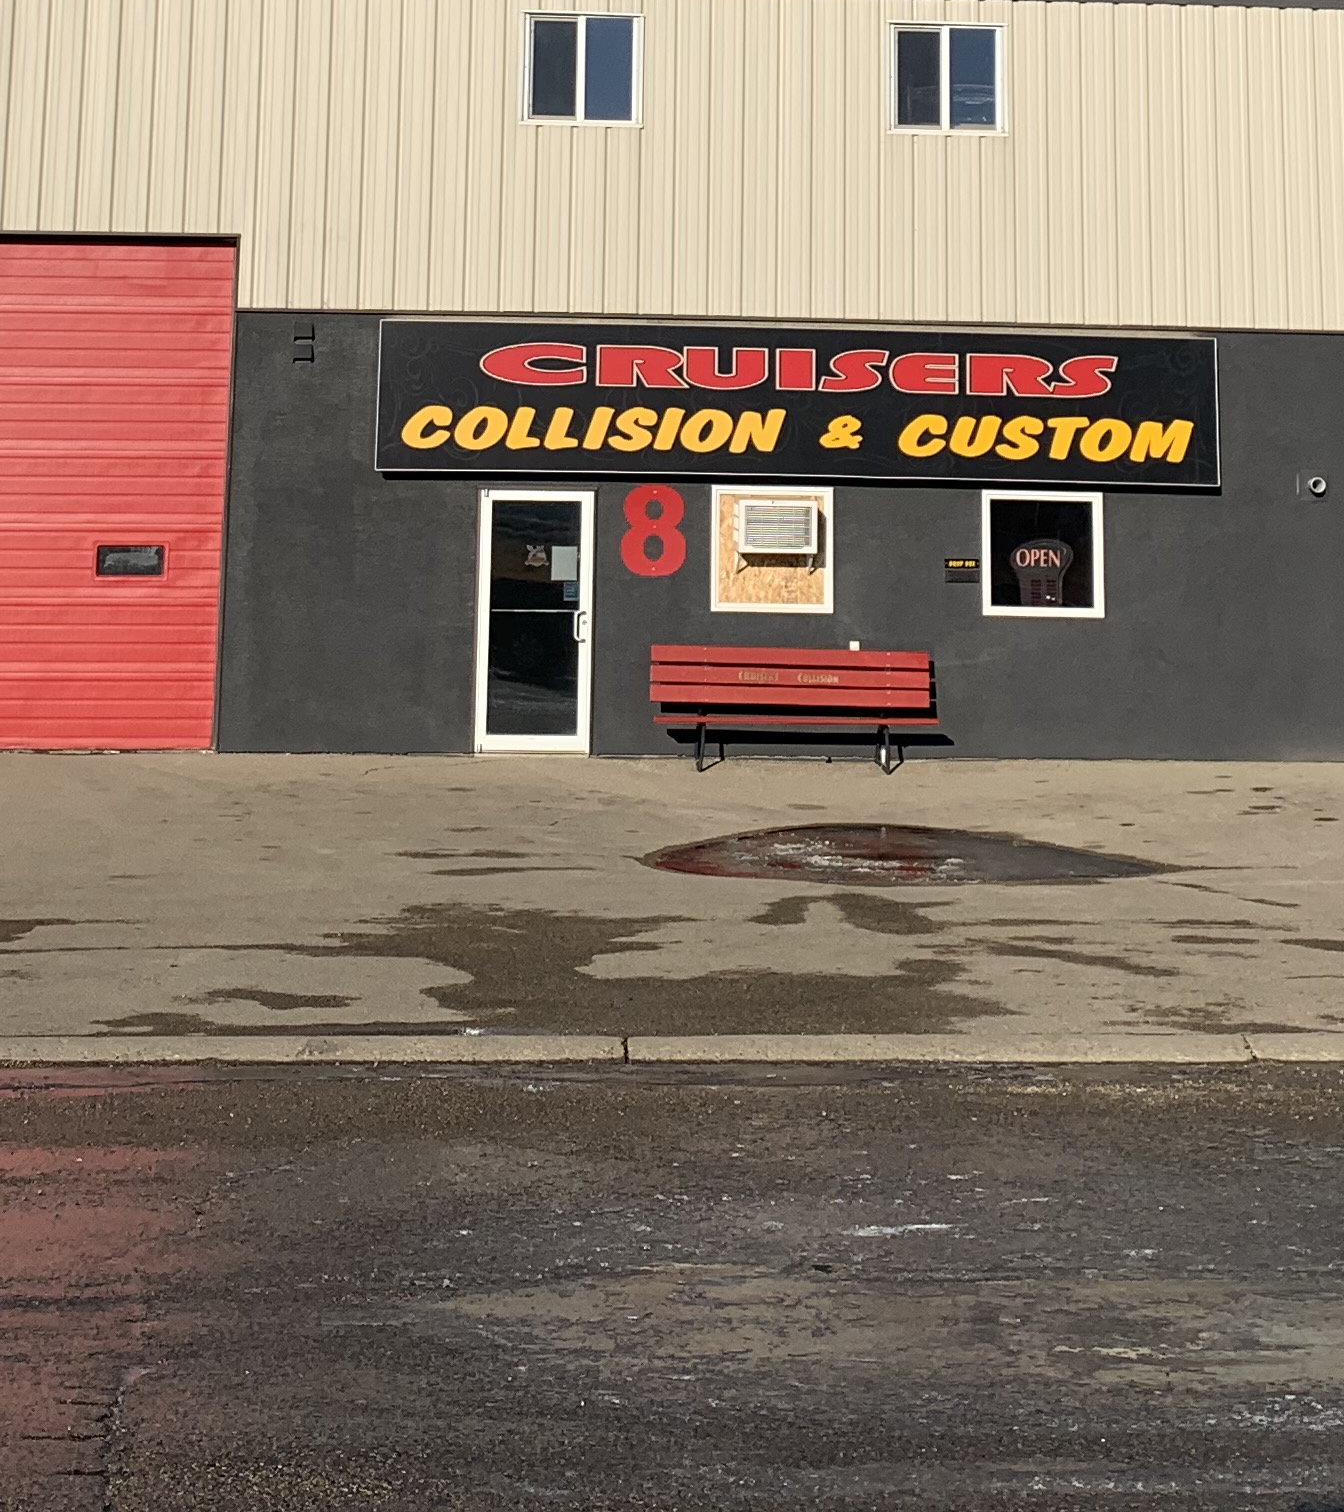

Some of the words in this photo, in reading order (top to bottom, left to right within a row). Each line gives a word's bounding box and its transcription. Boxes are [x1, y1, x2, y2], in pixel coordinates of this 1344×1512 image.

[479, 342, 1119, 399] CRUISERS
[400, 404, 787, 454] COLLISION
[818, 414, 864, 450] &
[897, 413, 1194, 464] CUSTOM
[621, 483, 687, 578] 8
[1015, 548, 1062, 569] OPEN
